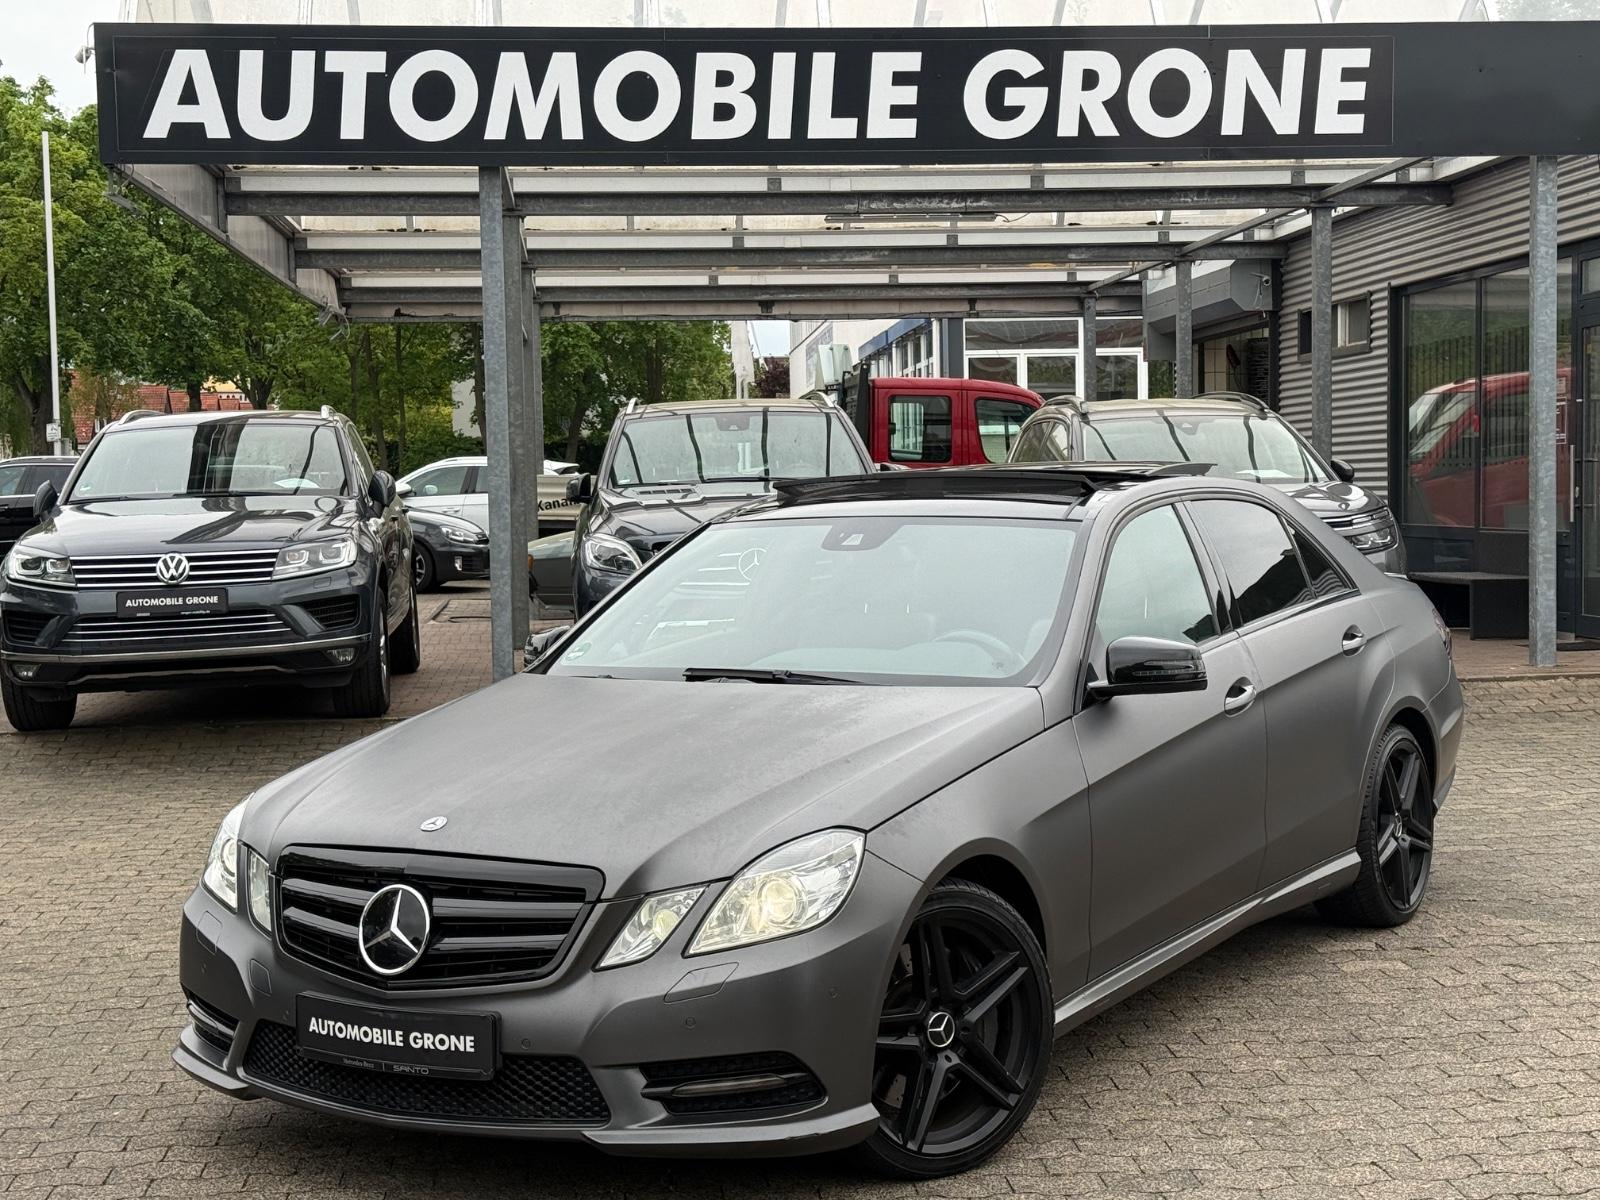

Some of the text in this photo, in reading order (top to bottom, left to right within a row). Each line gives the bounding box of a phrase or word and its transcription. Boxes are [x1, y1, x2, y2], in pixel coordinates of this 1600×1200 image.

[142, 46, 1372, 143] AUTOMOBILE GRONE
[157, 553, 189, 583] VW
[125, 596, 218, 607] AUTOMOBILE GRONE
[309, 1017, 475, 1053] AUTOMOBILE GRONE
[393, 1065, 429, 1075] SANTO
